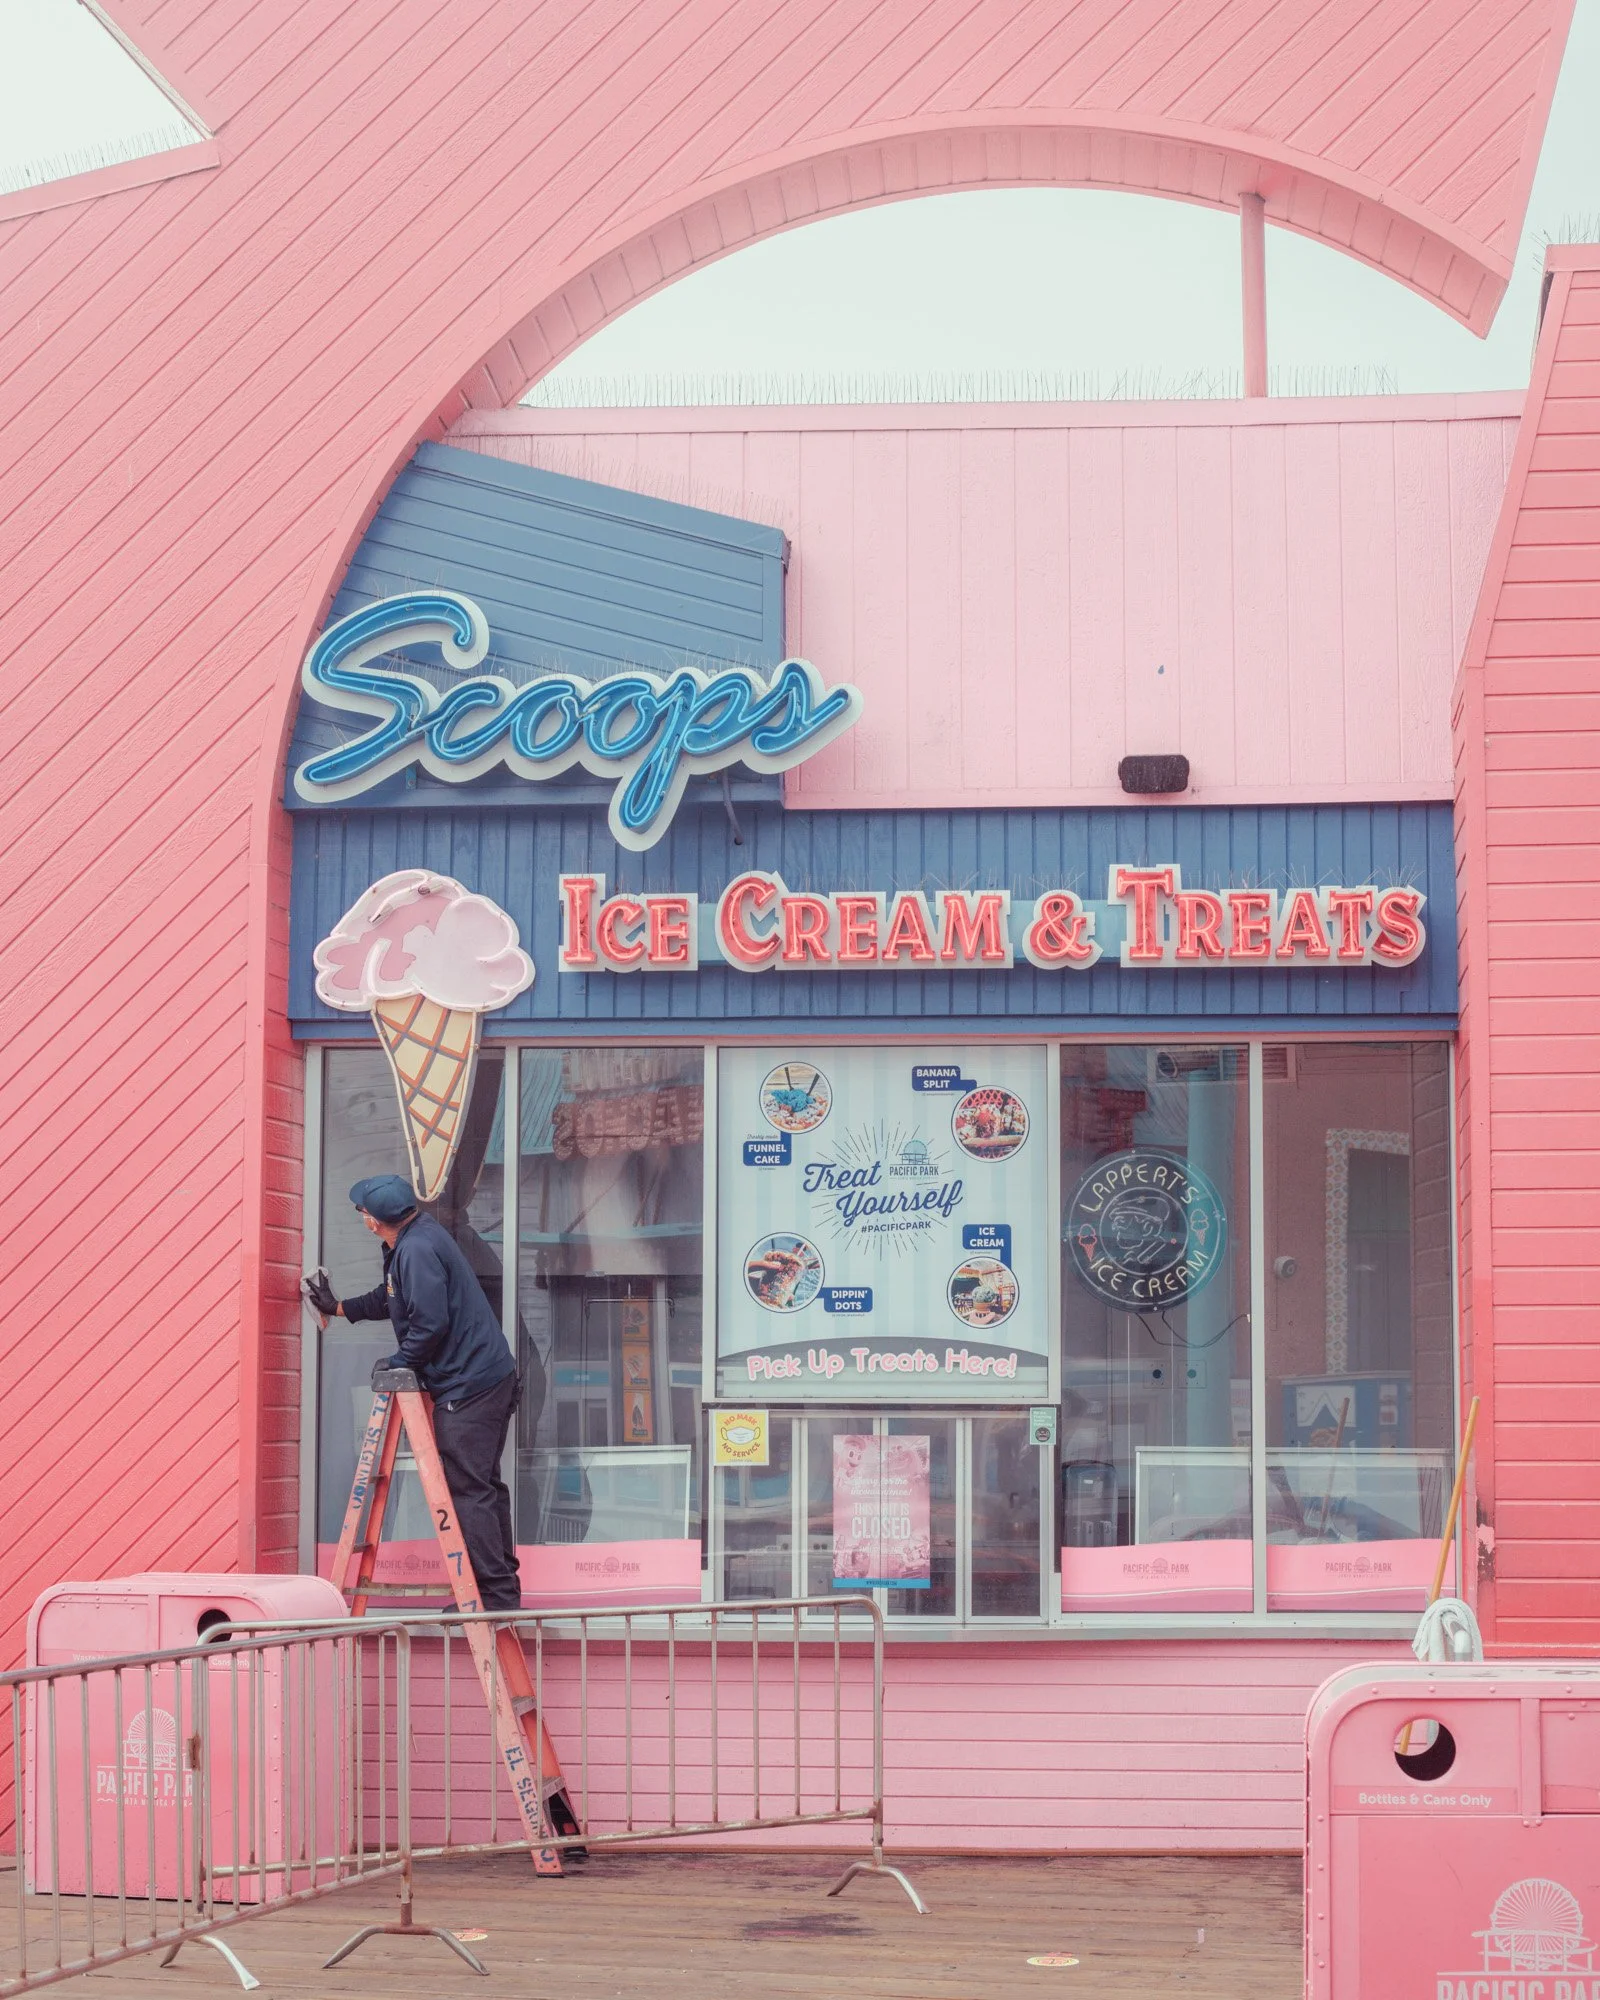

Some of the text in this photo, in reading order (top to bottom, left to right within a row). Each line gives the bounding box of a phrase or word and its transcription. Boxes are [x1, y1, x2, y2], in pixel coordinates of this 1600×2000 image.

[299, 592, 853, 840] Scoops
[561, 867, 1425, 968] ICE CREAM & TREATS
[916, 1068, 957, 1077] BANANA
[923, 1079, 950, 1089] SPLIT
[748, 1144, 787, 1153] FUNNEL
[754, 1155, 780, 1164] CAKE
[803, 1160, 882, 1192] Treat
[889, 1166, 939, 1176] PACIFIC PARK
[1079, 1163, 1200, 1212] LAPPERT'S
[836, 1179, 963, 1227] Yourself
[861, 1220, 932, 1234] #PACIFICPARK
[978, 1227, 996, 1236] ICE
[969, 1238, 1005, 1247] CREAM
[1090, 1249, 1210, 1299] ICE CREAM
[831, 1290, 868, 1299] DIPPIN'
[835, 1301, 862, 1310] DOTS
[747, 1347, 1018, 1379] Pick Up Treats Here!
[723, 1415, 735, 1426] NO
[721, 1441, 761, 1458] NO SERVICE
[851, 1516, 911, 1540] CLOSED
[575, 1562, 641, 1572] PACIFIC PARK
[1123, 1563, 1190, 1573] PACIFIC PARK
[1325, 1562, 1392, 1572] PACIFIC PARK
[1359, 1792, 1492, 1808] Bottles & Cans Only
